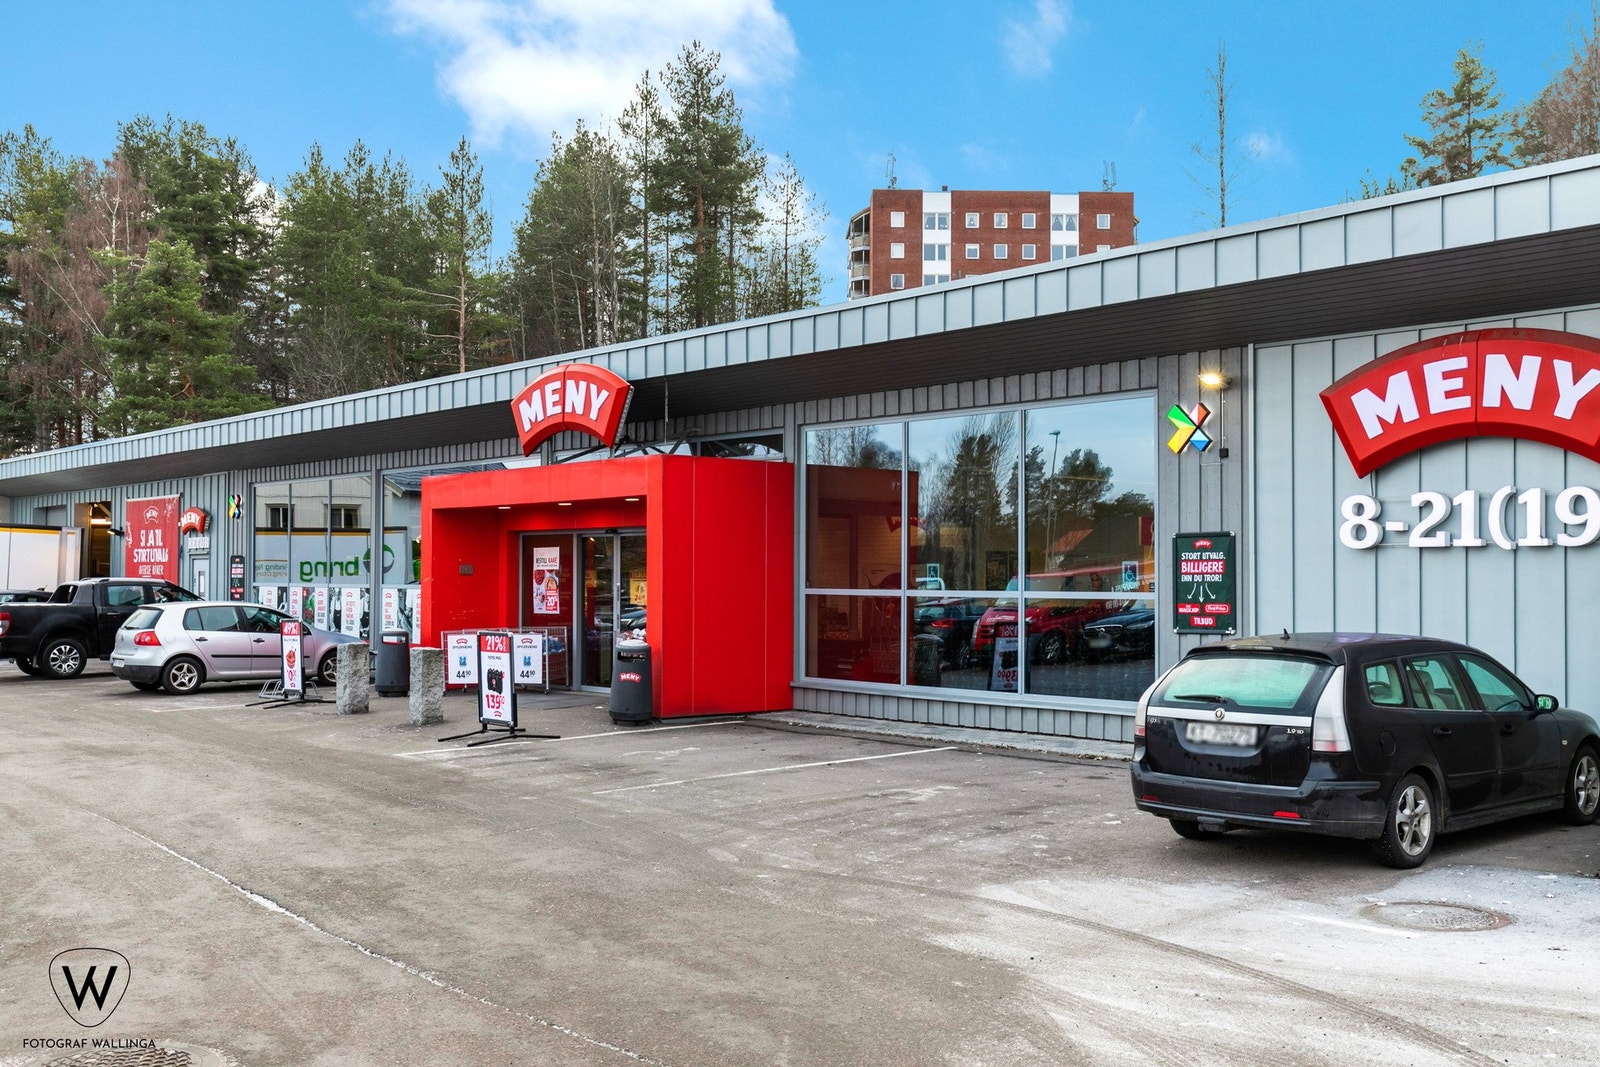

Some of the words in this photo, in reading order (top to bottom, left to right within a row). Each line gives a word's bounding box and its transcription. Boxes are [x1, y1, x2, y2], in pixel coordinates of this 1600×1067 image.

[1350, 353, 1600, 440] MENY
[518, 379, 610, 433] MENY
[180, 512, 200, 528] MENY
[1181, 552, 1200, 560] STORT
[1202, 551, 1226, 560] UTVALG.
[1181, 561, 1224, 573] BILLIGERE
[1194, 574, 1203, 582] DU
[485, 635, 503, 651] 21%
[620, 673, 640, 681] MENY
